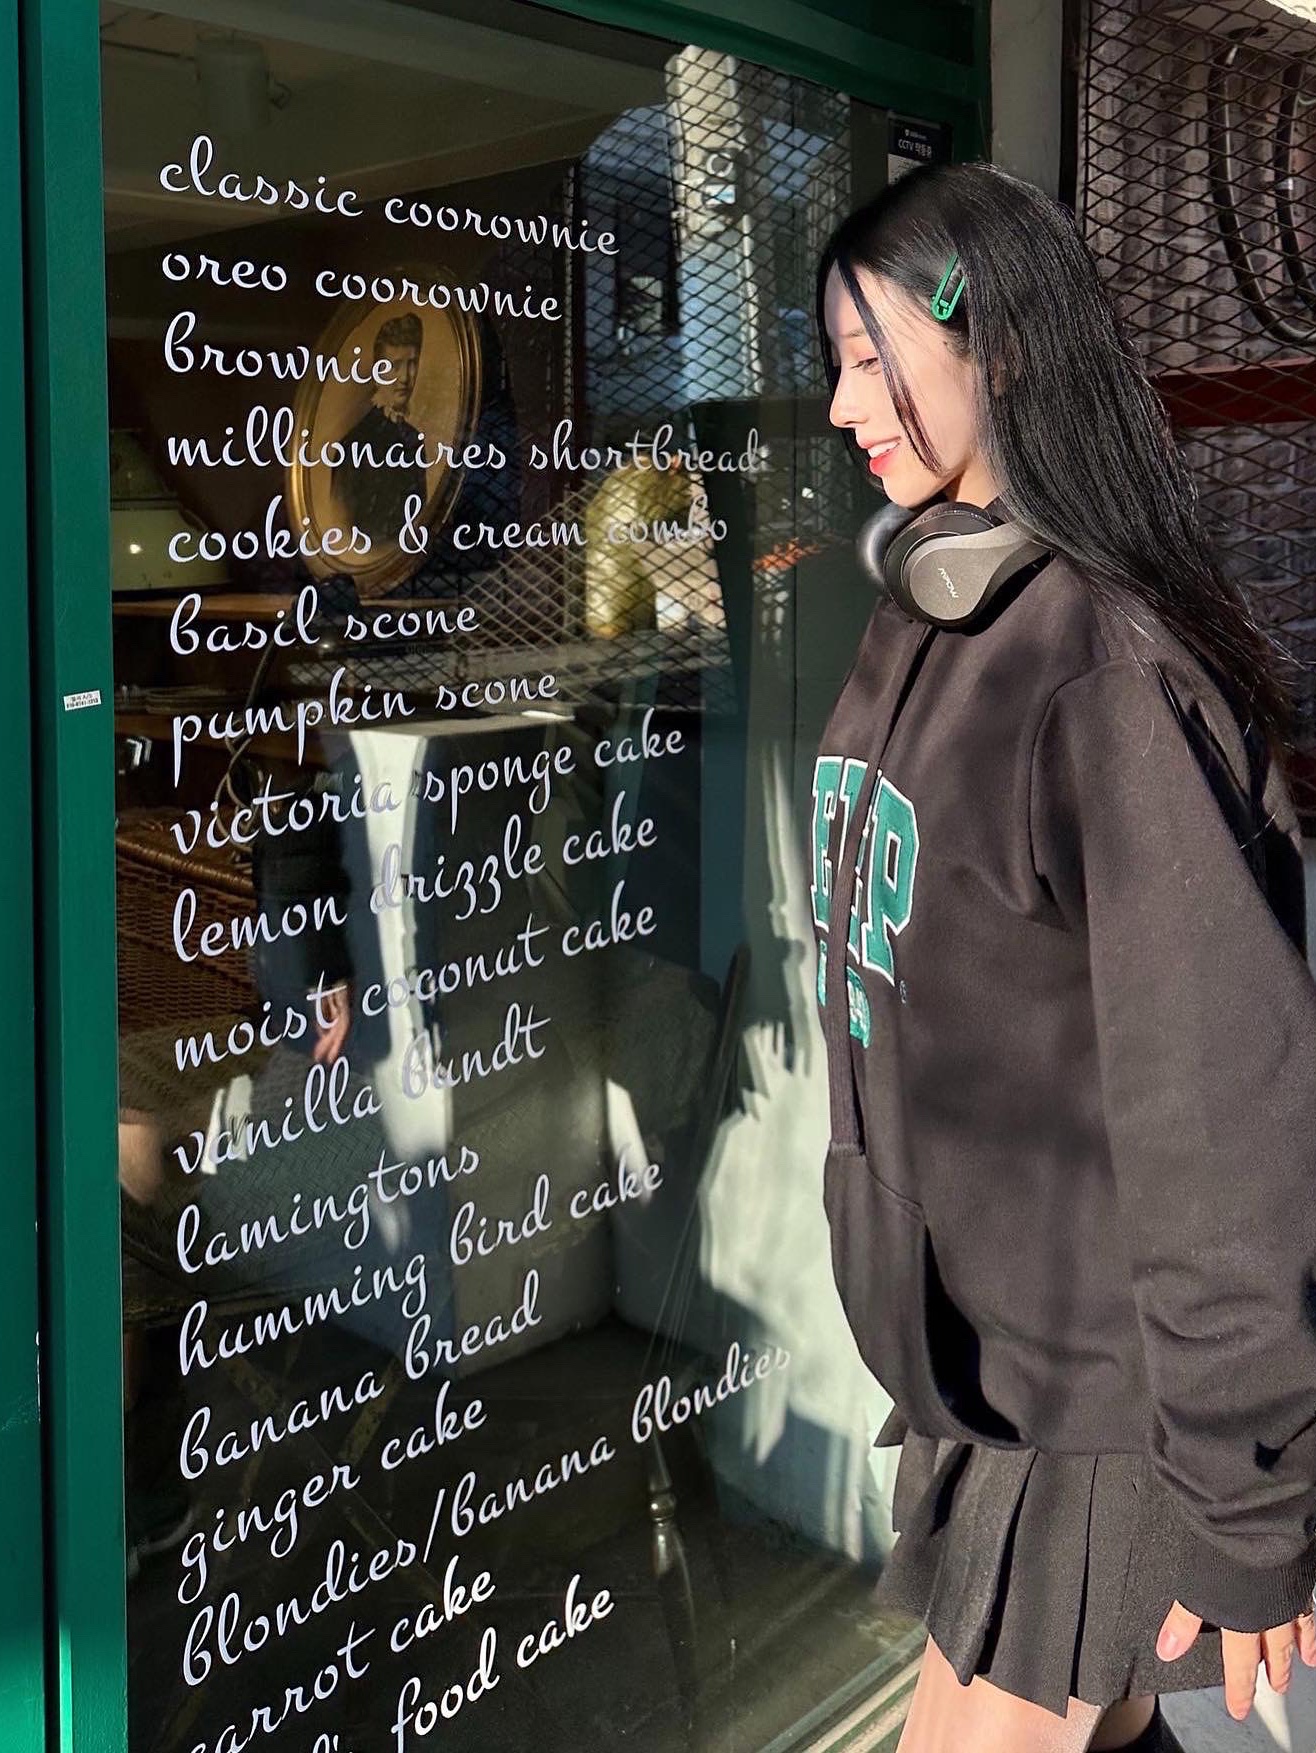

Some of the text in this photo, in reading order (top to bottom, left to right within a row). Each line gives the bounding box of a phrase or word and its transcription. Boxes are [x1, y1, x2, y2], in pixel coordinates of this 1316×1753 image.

[159, 135, 620, 256] classic coorownie
[162, 248, 563, 321] oreo coorownie
[164, 311, 399, 387] brownie
[167, 406, 763, 474] millionaires shortbread
[168, 494, 728, 563] cookies & cream combo
[169, 585, 480, 656] basil scone
[170, 707, 686, 857] victoria sponge cake
[172, 666, 560, 788] pumpkin scone
[173, 790, 658, 963] lemon drizzle cake
[174, 879, 658, 1071] moist coconut cake
[173, 1003, 552, 1176] vanilla bundt
[176, 1142, 481, 1275] lamingtons
[179, 1146, 663, 1377] humming bird cake
[180, 1269, 543, 1482] banana bread
[631, 1341, 792, 1445] blondies
[177, 1380, 487, 1605] ginger cake
[389, 1555, 495, 1658] cake
[391, 1573, 615, 1753] food cake
